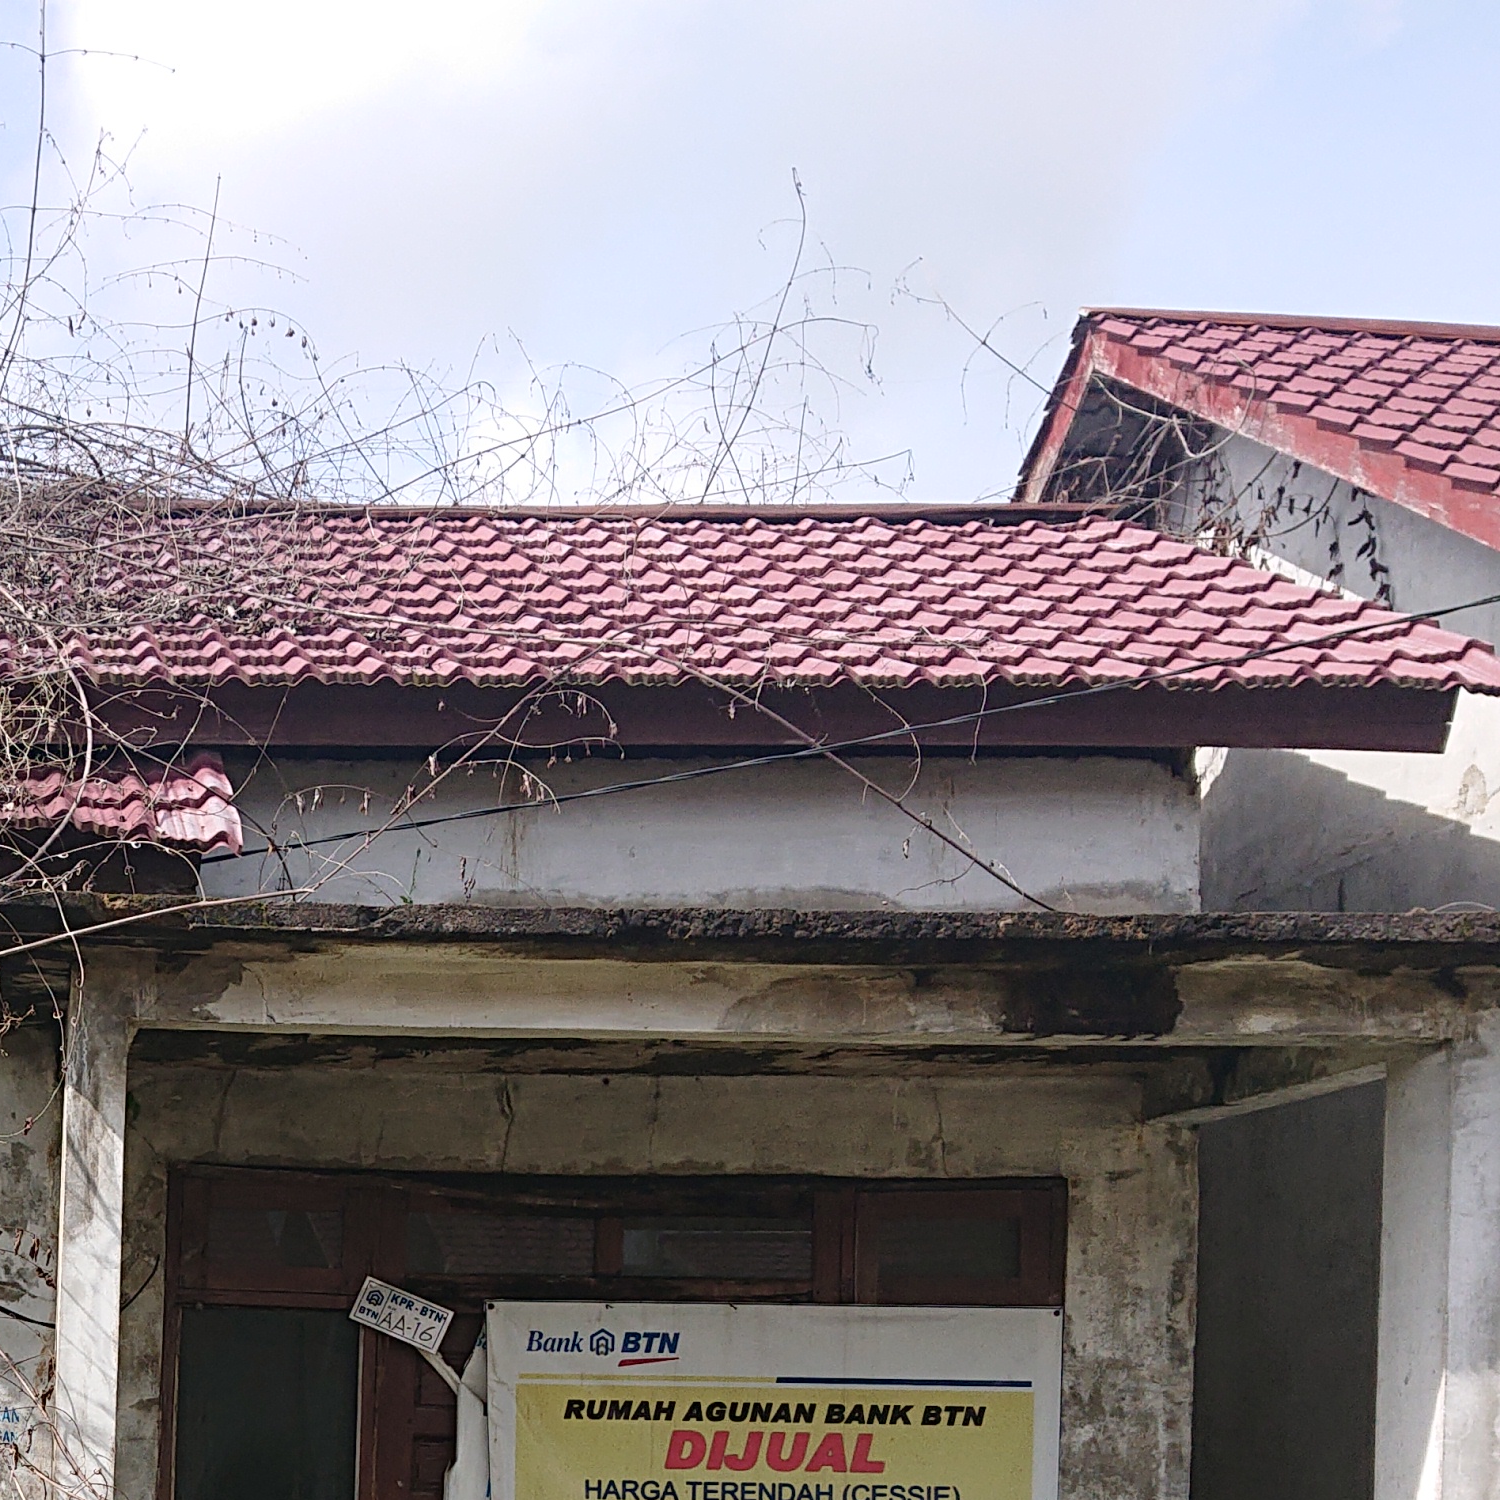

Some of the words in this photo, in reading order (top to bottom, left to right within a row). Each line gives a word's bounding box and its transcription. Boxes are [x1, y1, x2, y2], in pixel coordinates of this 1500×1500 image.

[358, 1305, 379, 1320] BTN
[380, 1312, 436, 1342] AA-16
[526, 1329, 584, 1353] Bank
[620, 1331, 681, 1354] BTN
[563, 1398, 677, 1421] RUMAH
[681, 1400, 817, 1424] AGUNAN
[824, 1403, 914, 1426] BANK
[920, 1405, 987, 1427] BTN
[664, 1429, 886, 1474] DIJUAL
